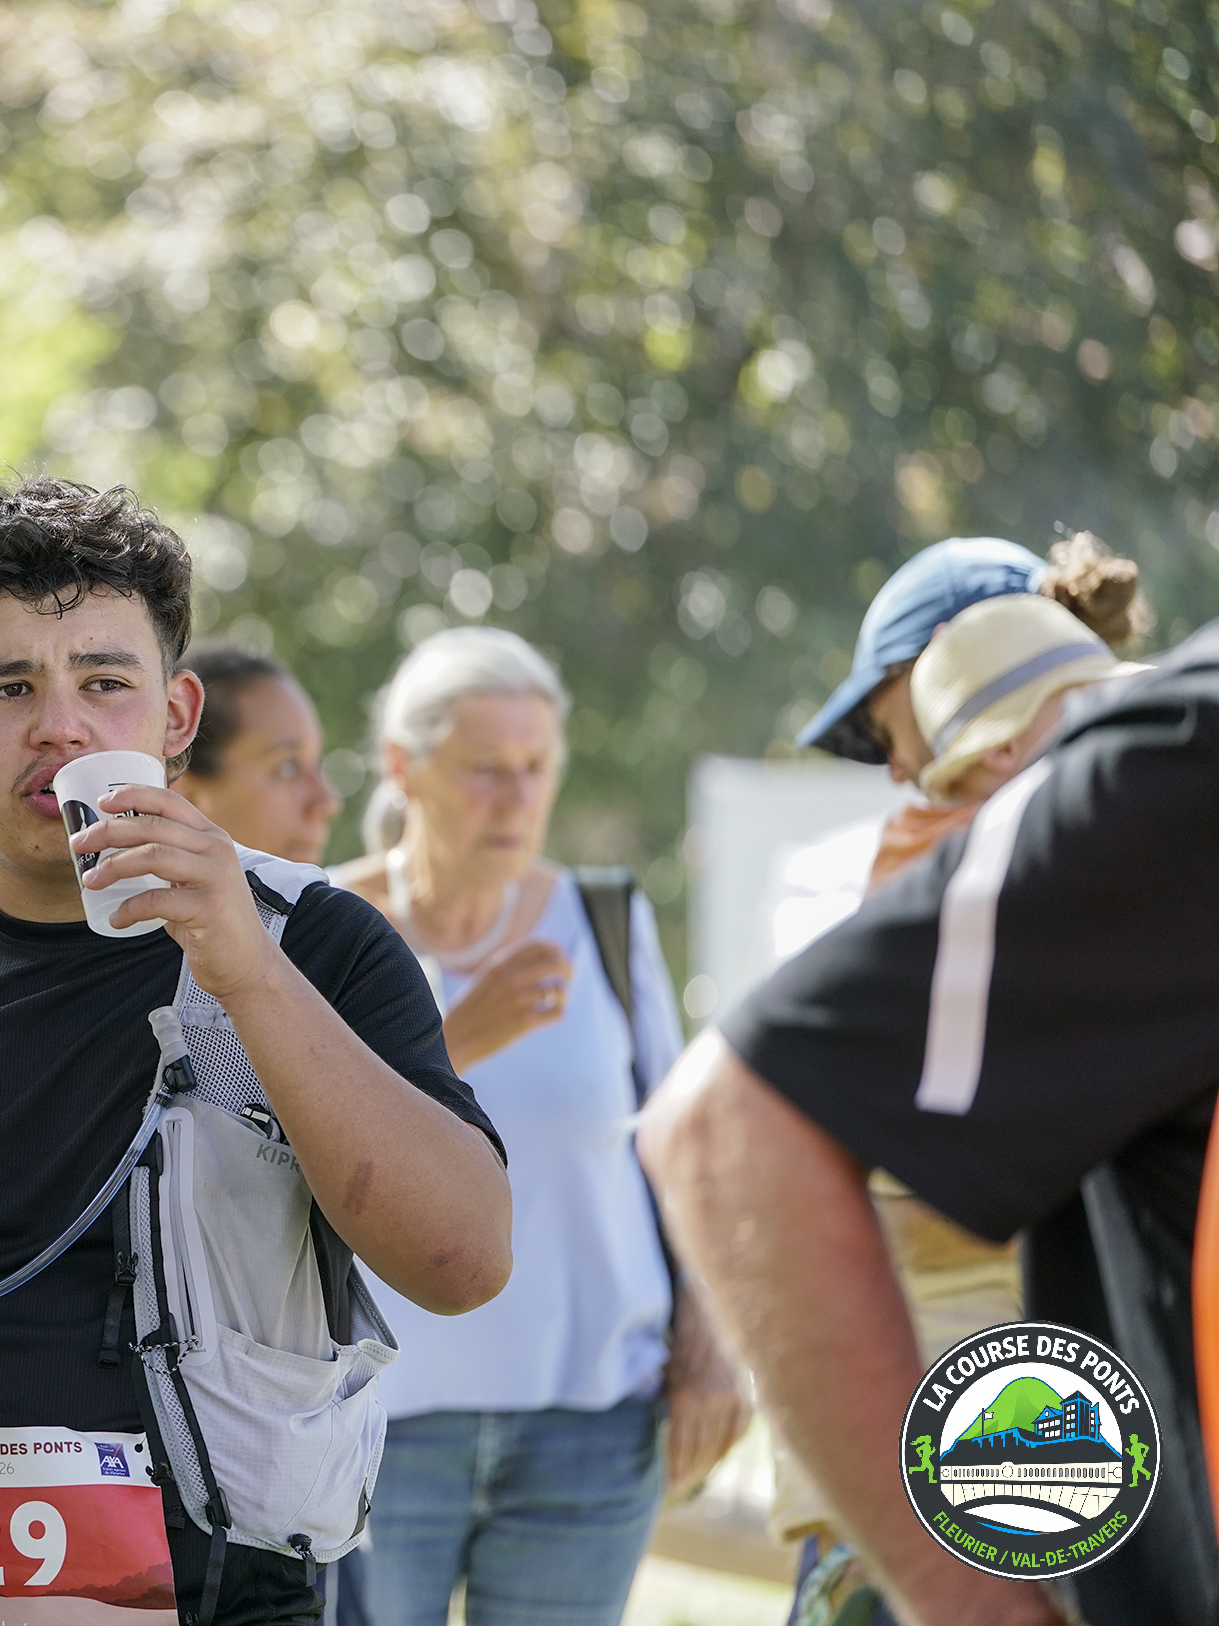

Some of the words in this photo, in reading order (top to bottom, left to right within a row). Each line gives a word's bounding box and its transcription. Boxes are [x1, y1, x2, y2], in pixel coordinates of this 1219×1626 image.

[0, 1443, 28, 1456] DES
[33, 1441, 83, 1454] PONTS
[100, 1455, 125, 1468] AXA
